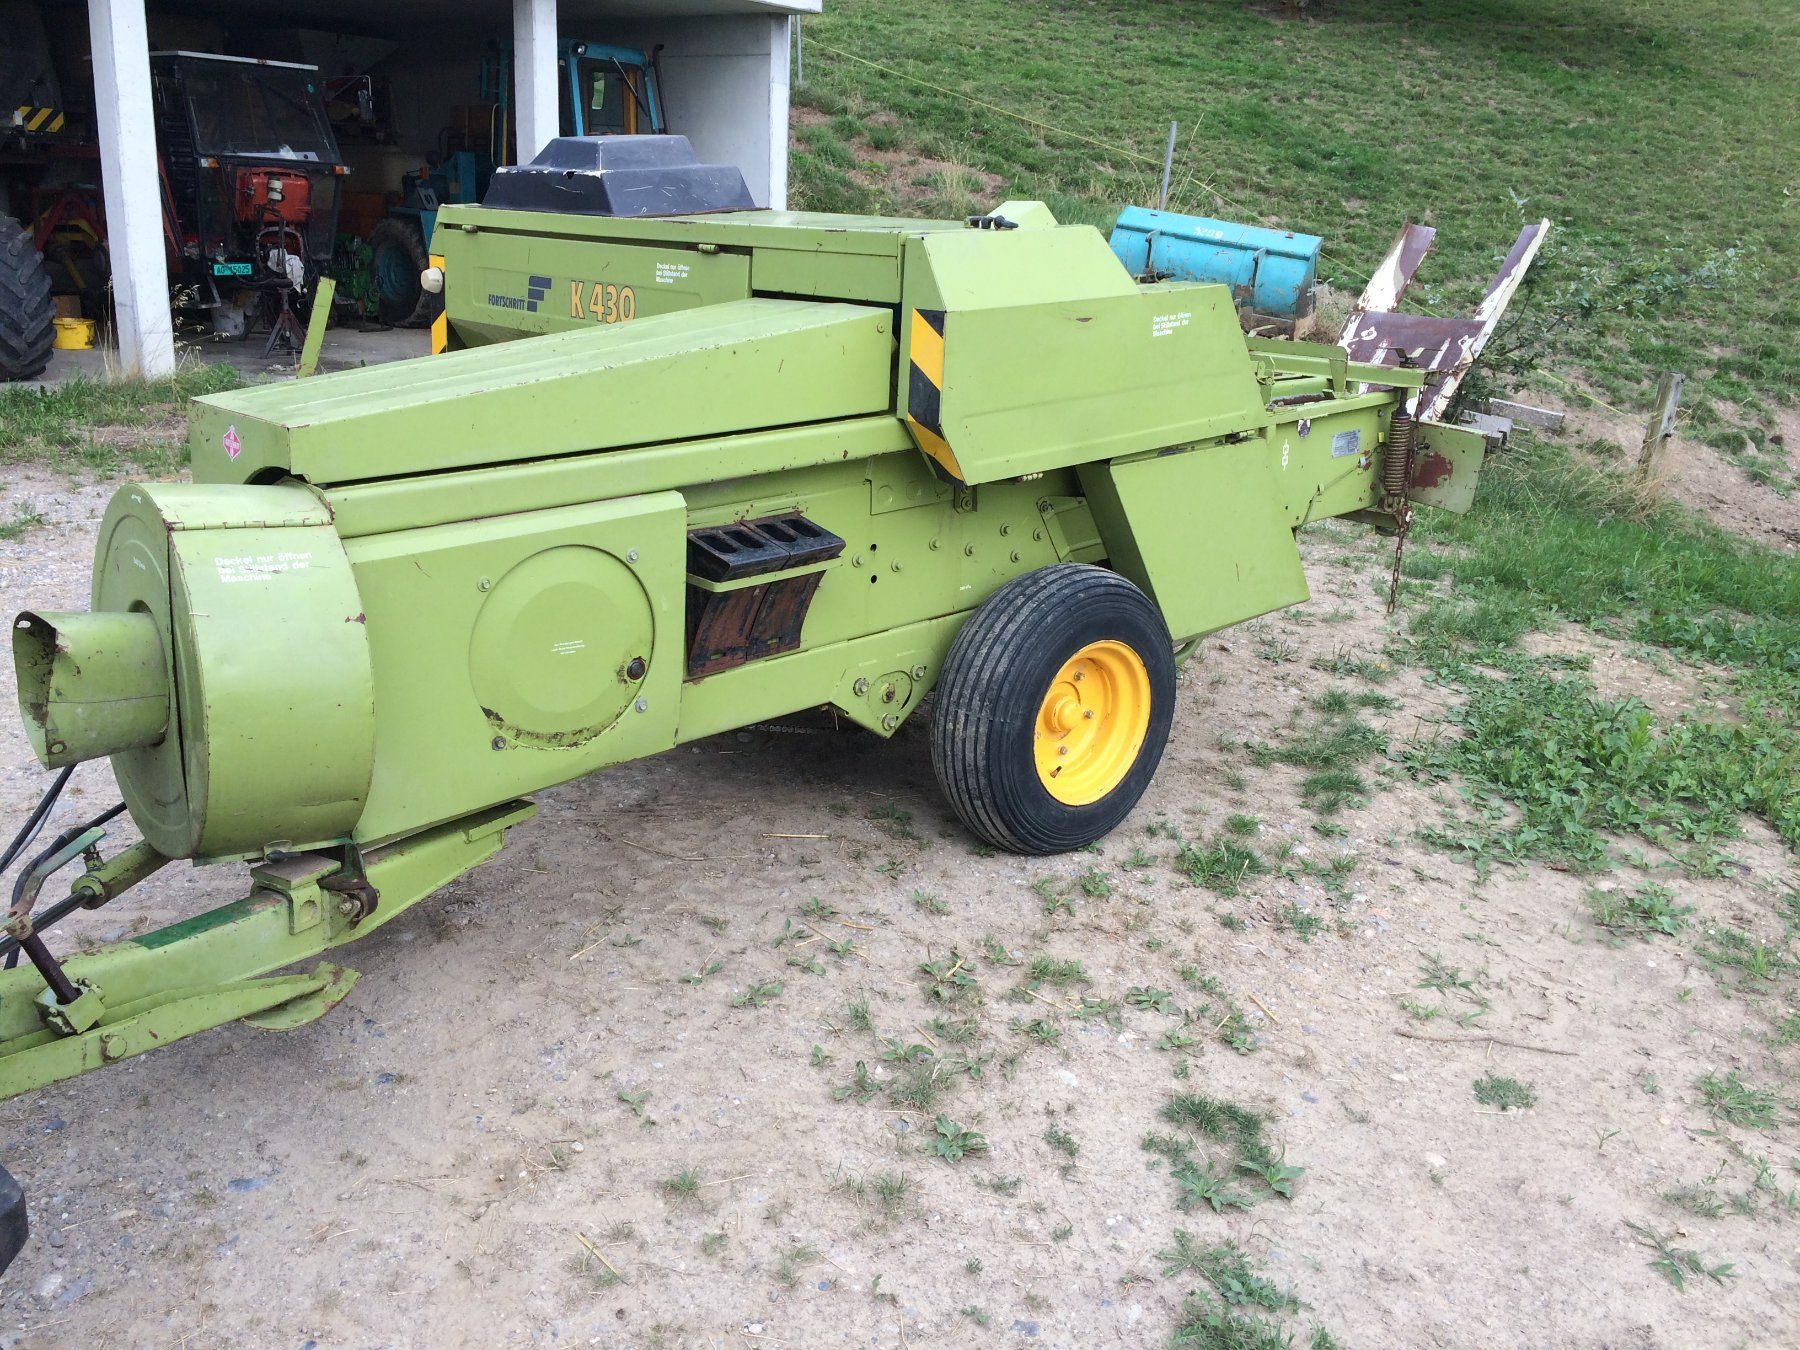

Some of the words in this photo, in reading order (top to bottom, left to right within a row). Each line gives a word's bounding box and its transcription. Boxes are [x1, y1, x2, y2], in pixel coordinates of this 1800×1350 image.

[488, 294, 526, 311] FORTSCHRITT
[570, 279, 585, 319] K
[589, 282, 636, 324] 430
[214, 555, 253, 567] Deckel
[256, 555, 273, 564] nur
[277, 551, 312, 562] öffnen
[218, 565, 236, 575] bei
[291, 560, 310, 570] der
[220, 573, 273, 584] Maschine
